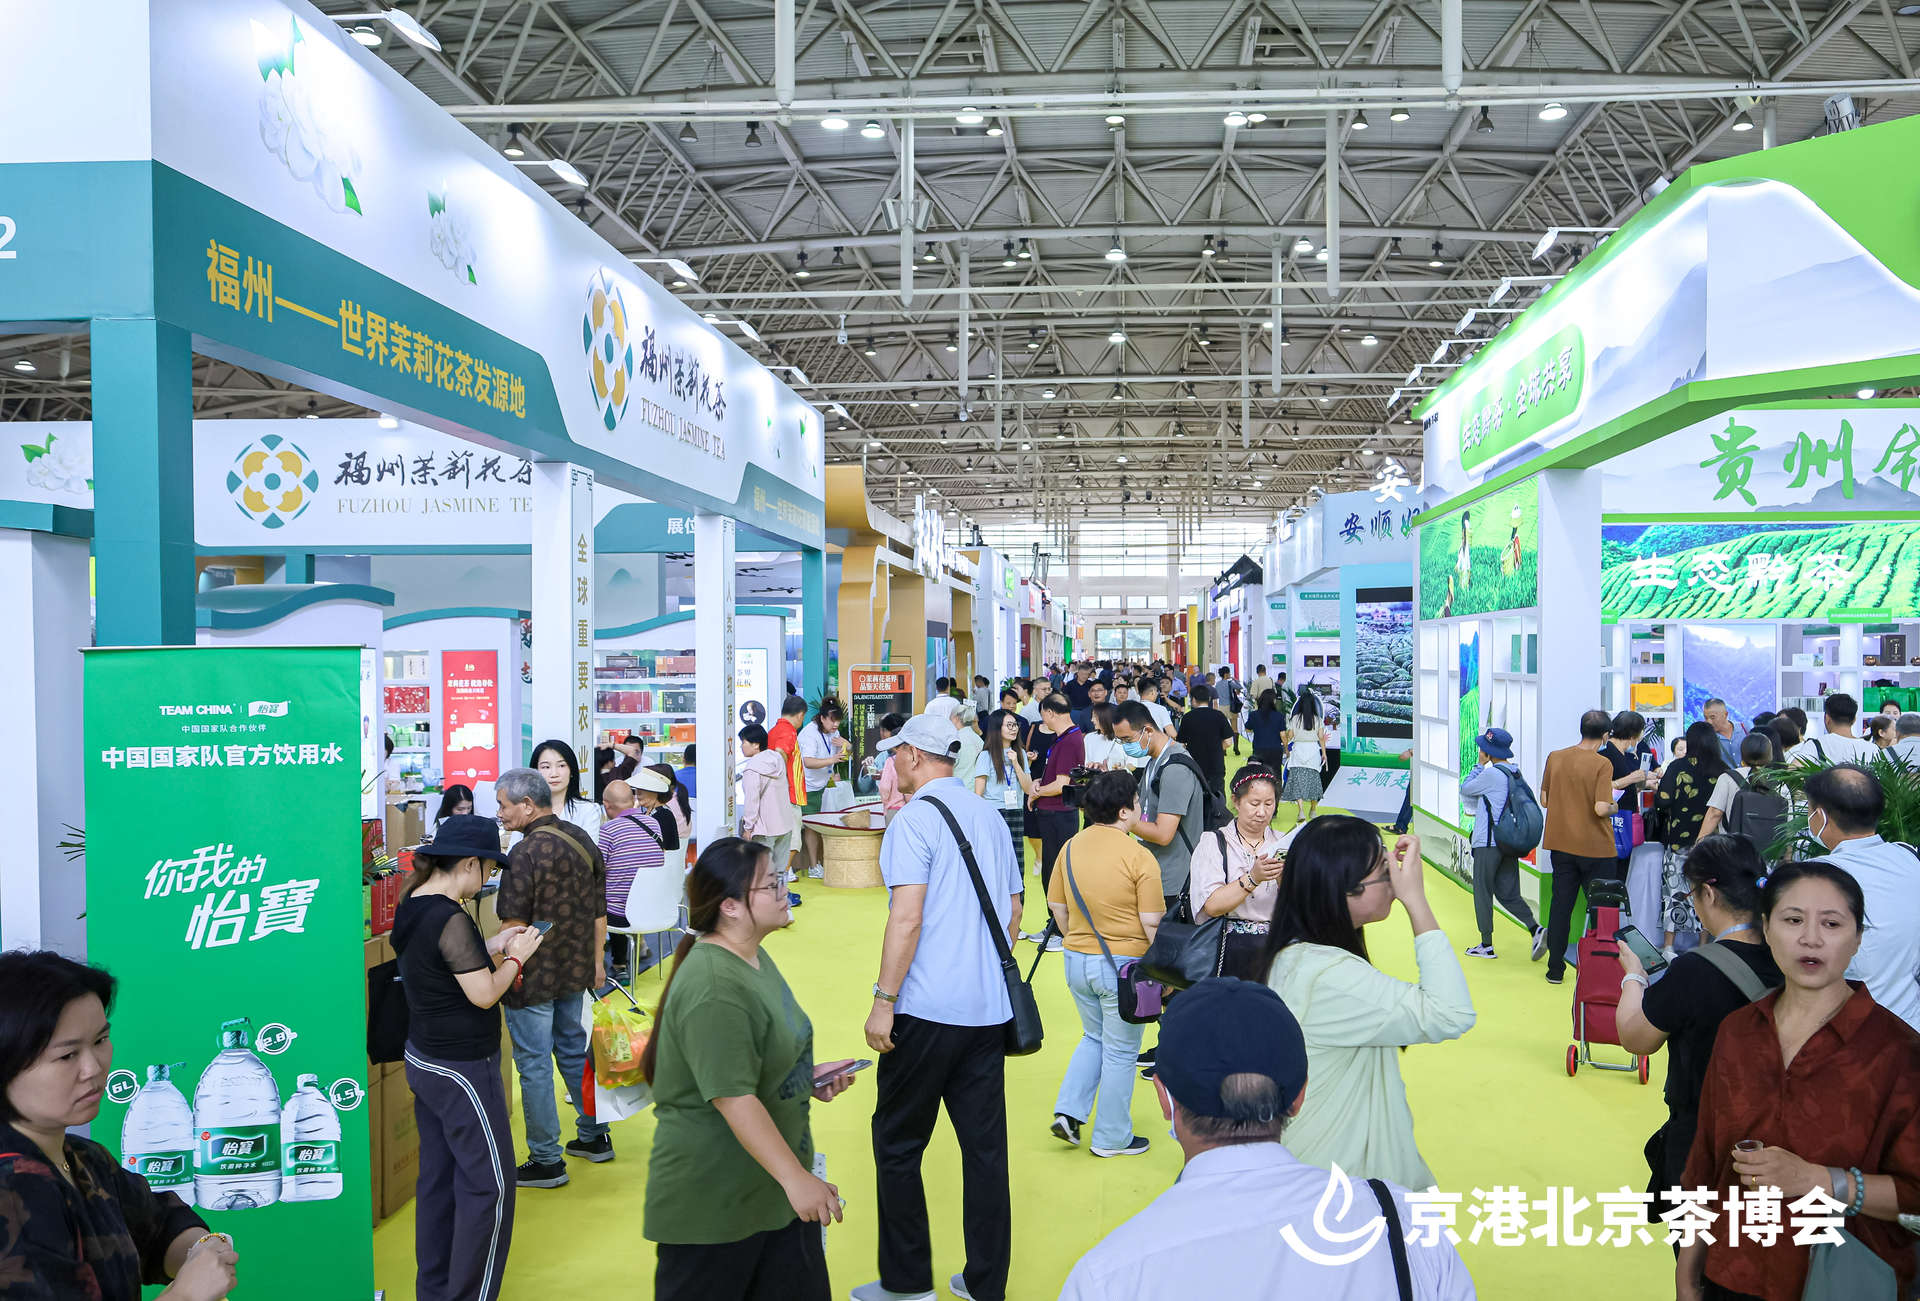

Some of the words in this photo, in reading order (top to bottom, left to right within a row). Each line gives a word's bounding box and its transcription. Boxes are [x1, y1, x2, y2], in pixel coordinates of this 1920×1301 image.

[0, 216, 17, 259] 2
[640, 325, 727, 421] 福州茉莉花茶
[641, 397, 676, 435] FUZHOU
[679, 416, 709, 452] JASMINE
[713, 434, 726, 461] TEA
[338, 498, 412, 514] FUZHOU
[421, 497, 500, 514] JASMINE
[159, 705, 193, 715] TEAM
[195, 704, 232, 715] CHINA
[181, 724, 267, 733] 中国国家队合作伙伴
[101, 742, 345, 769] 中国国家队官方饮用水
[143, 843, 268, 900] 你我的
[184, 878, 320, 950] 怡寶
[112, 1080, 134, 1094] 6L
[221, 1140, 254, 1156] 怡寶
